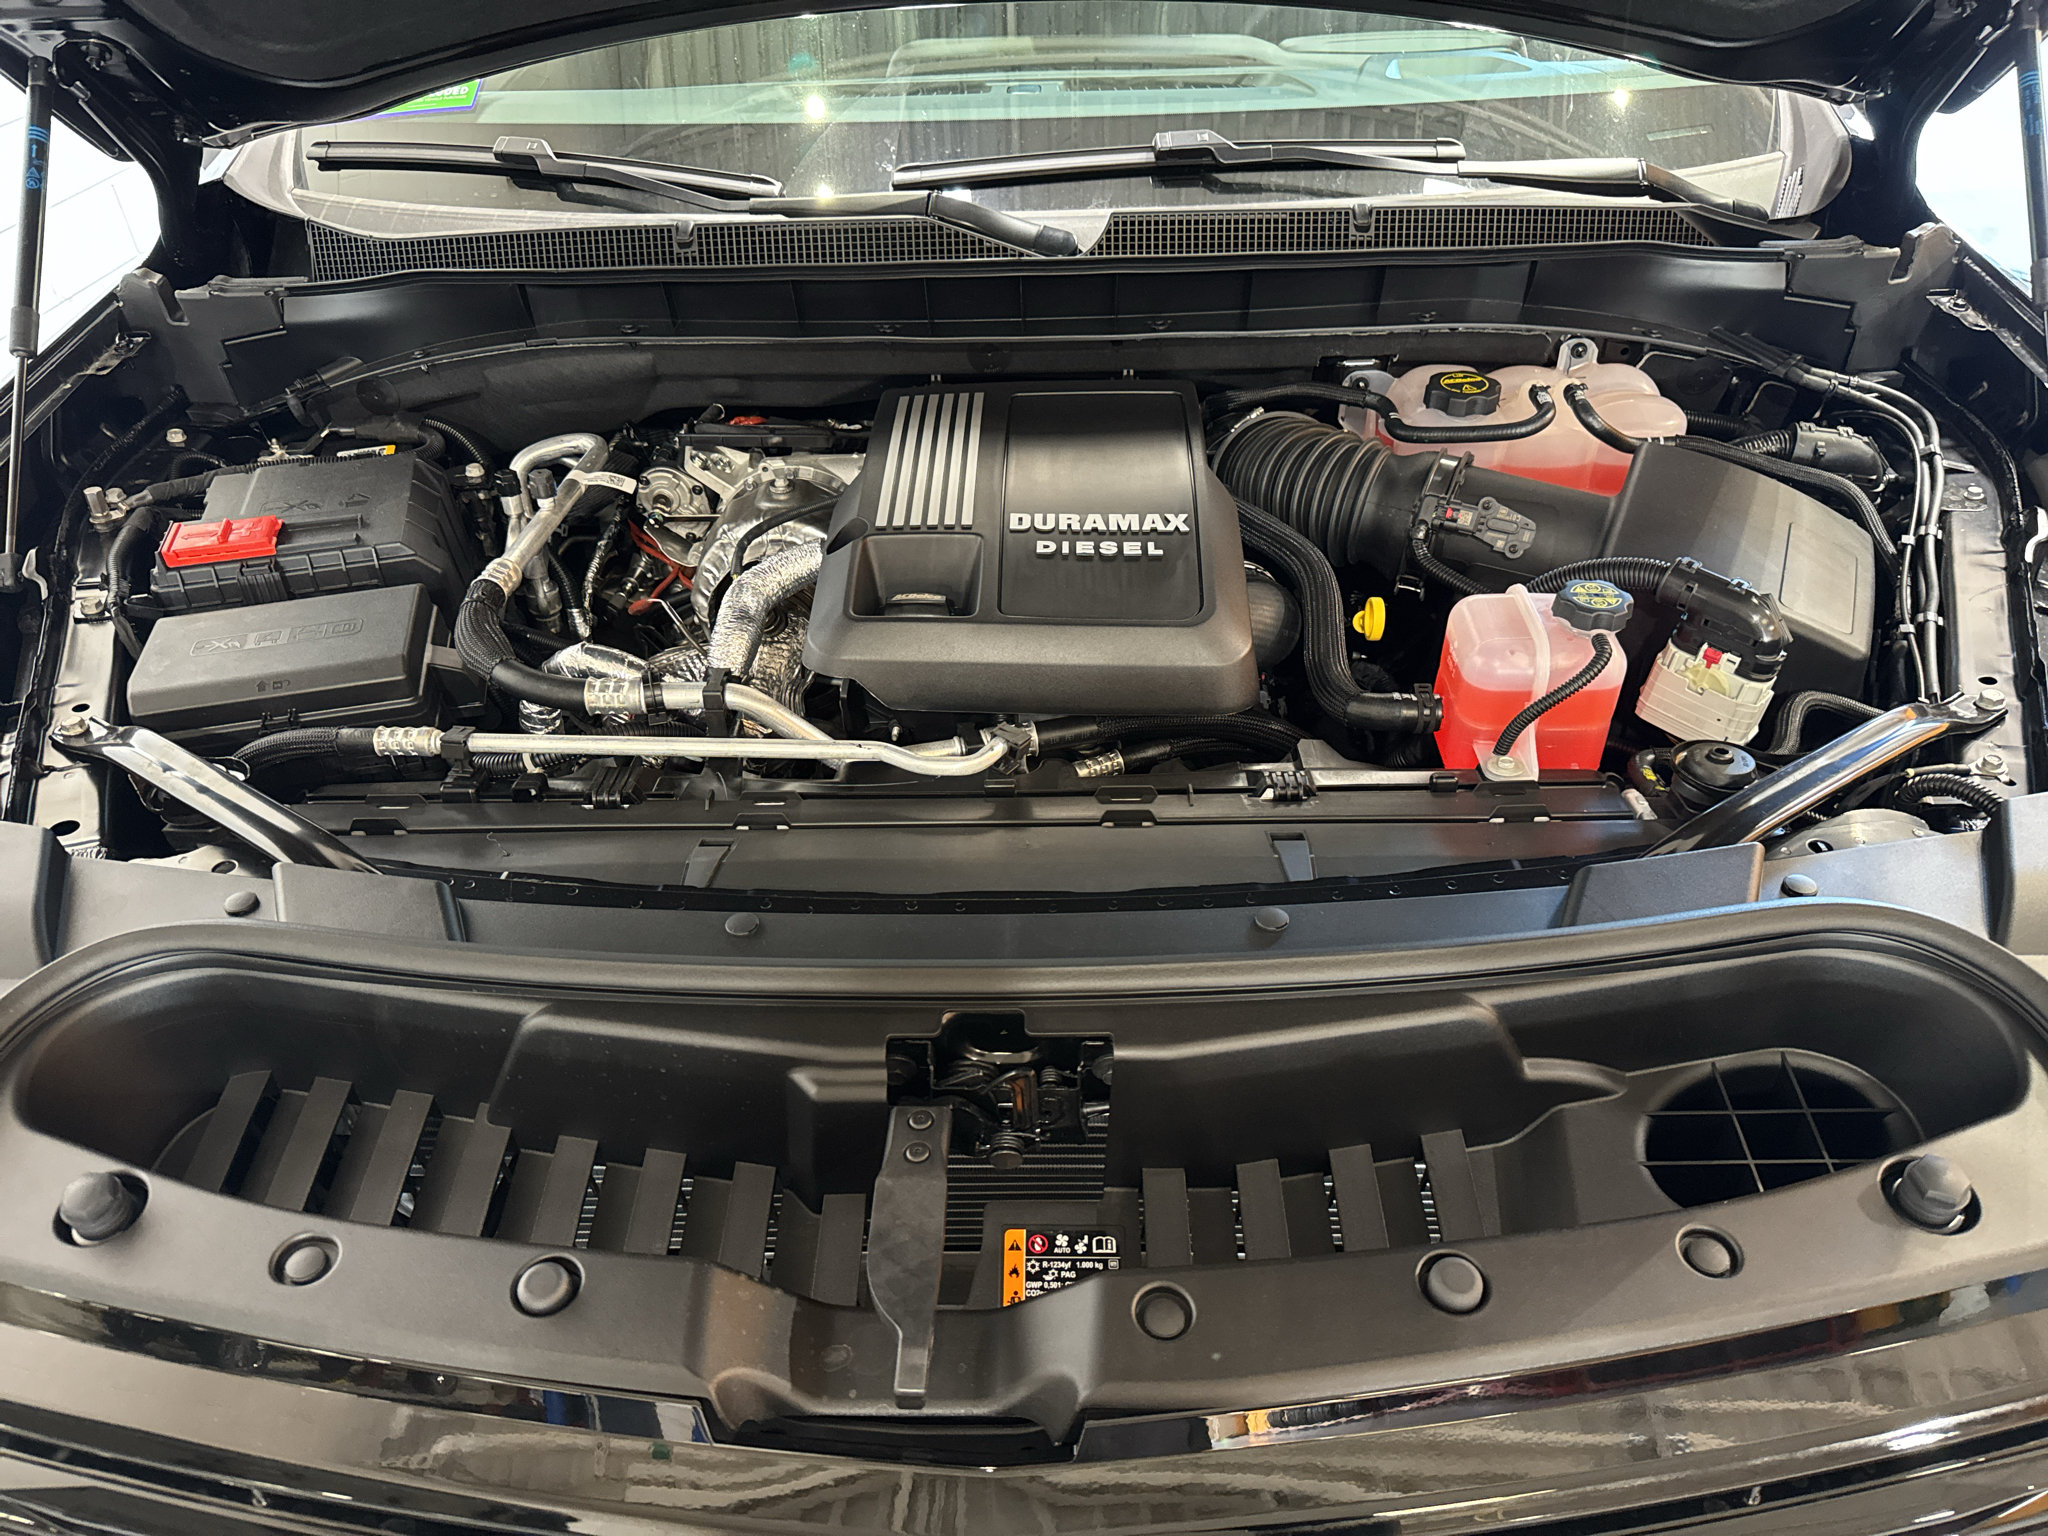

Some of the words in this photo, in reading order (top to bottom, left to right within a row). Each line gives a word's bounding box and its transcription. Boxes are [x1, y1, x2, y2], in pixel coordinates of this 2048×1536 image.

[1008, 513, 1190, 532] DURAMAX
[1035, 540, 1164, 557] DIESEL
[1042, 1261, 1071, 1270] R-1234yf
[1095, 1261, 1103, 1270] kg
